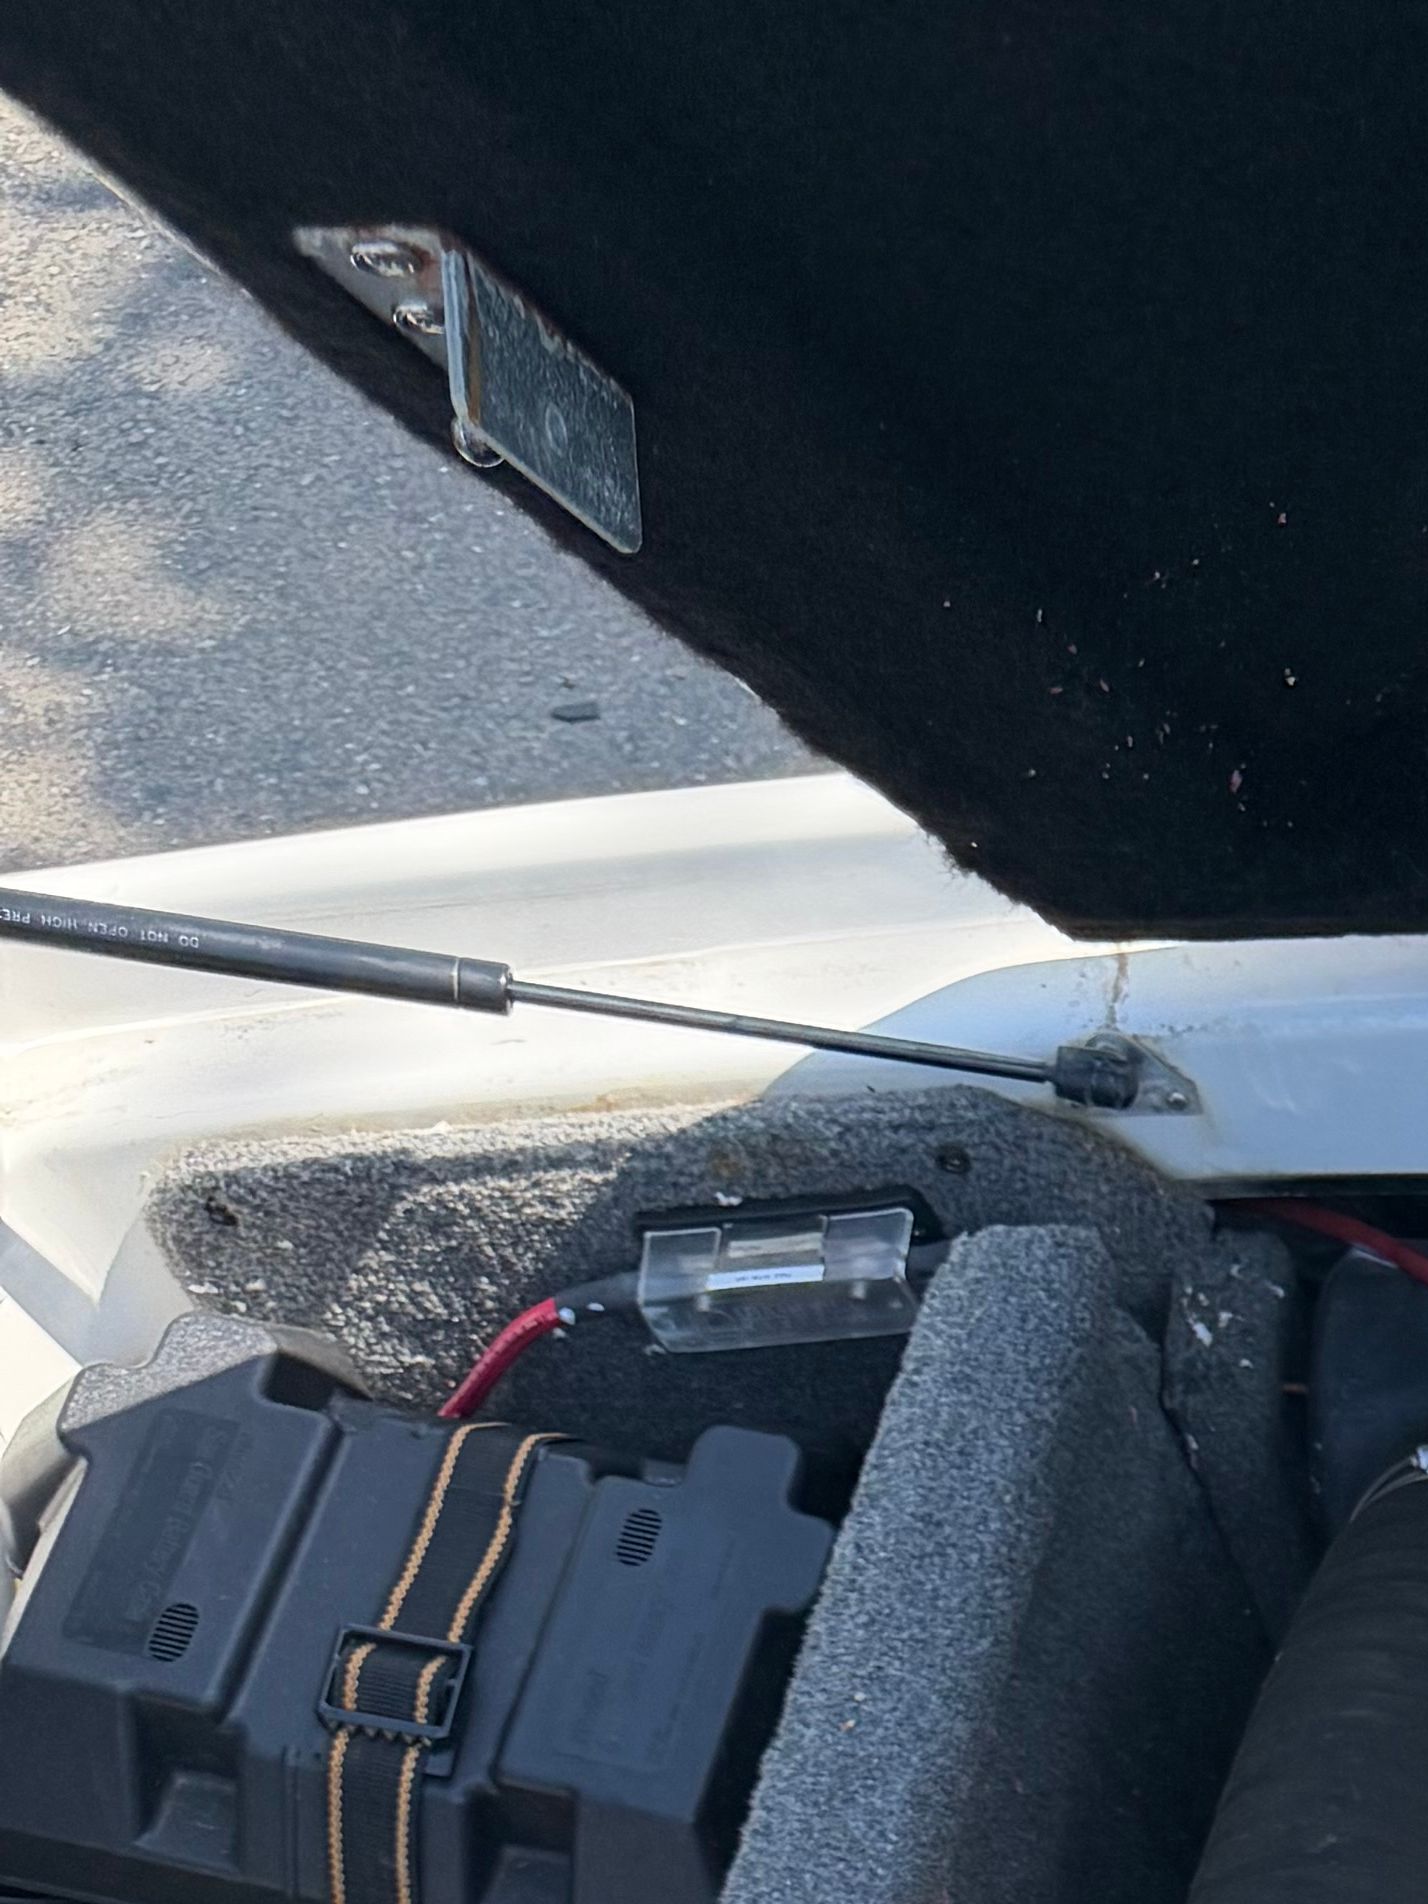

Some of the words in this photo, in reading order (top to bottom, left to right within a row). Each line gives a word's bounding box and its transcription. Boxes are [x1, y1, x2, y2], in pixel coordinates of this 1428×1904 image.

[0, 907, 31, 924] PRE
[87, 922, 129, 938] OPEN
[140, 929, 169, 943] NOT
